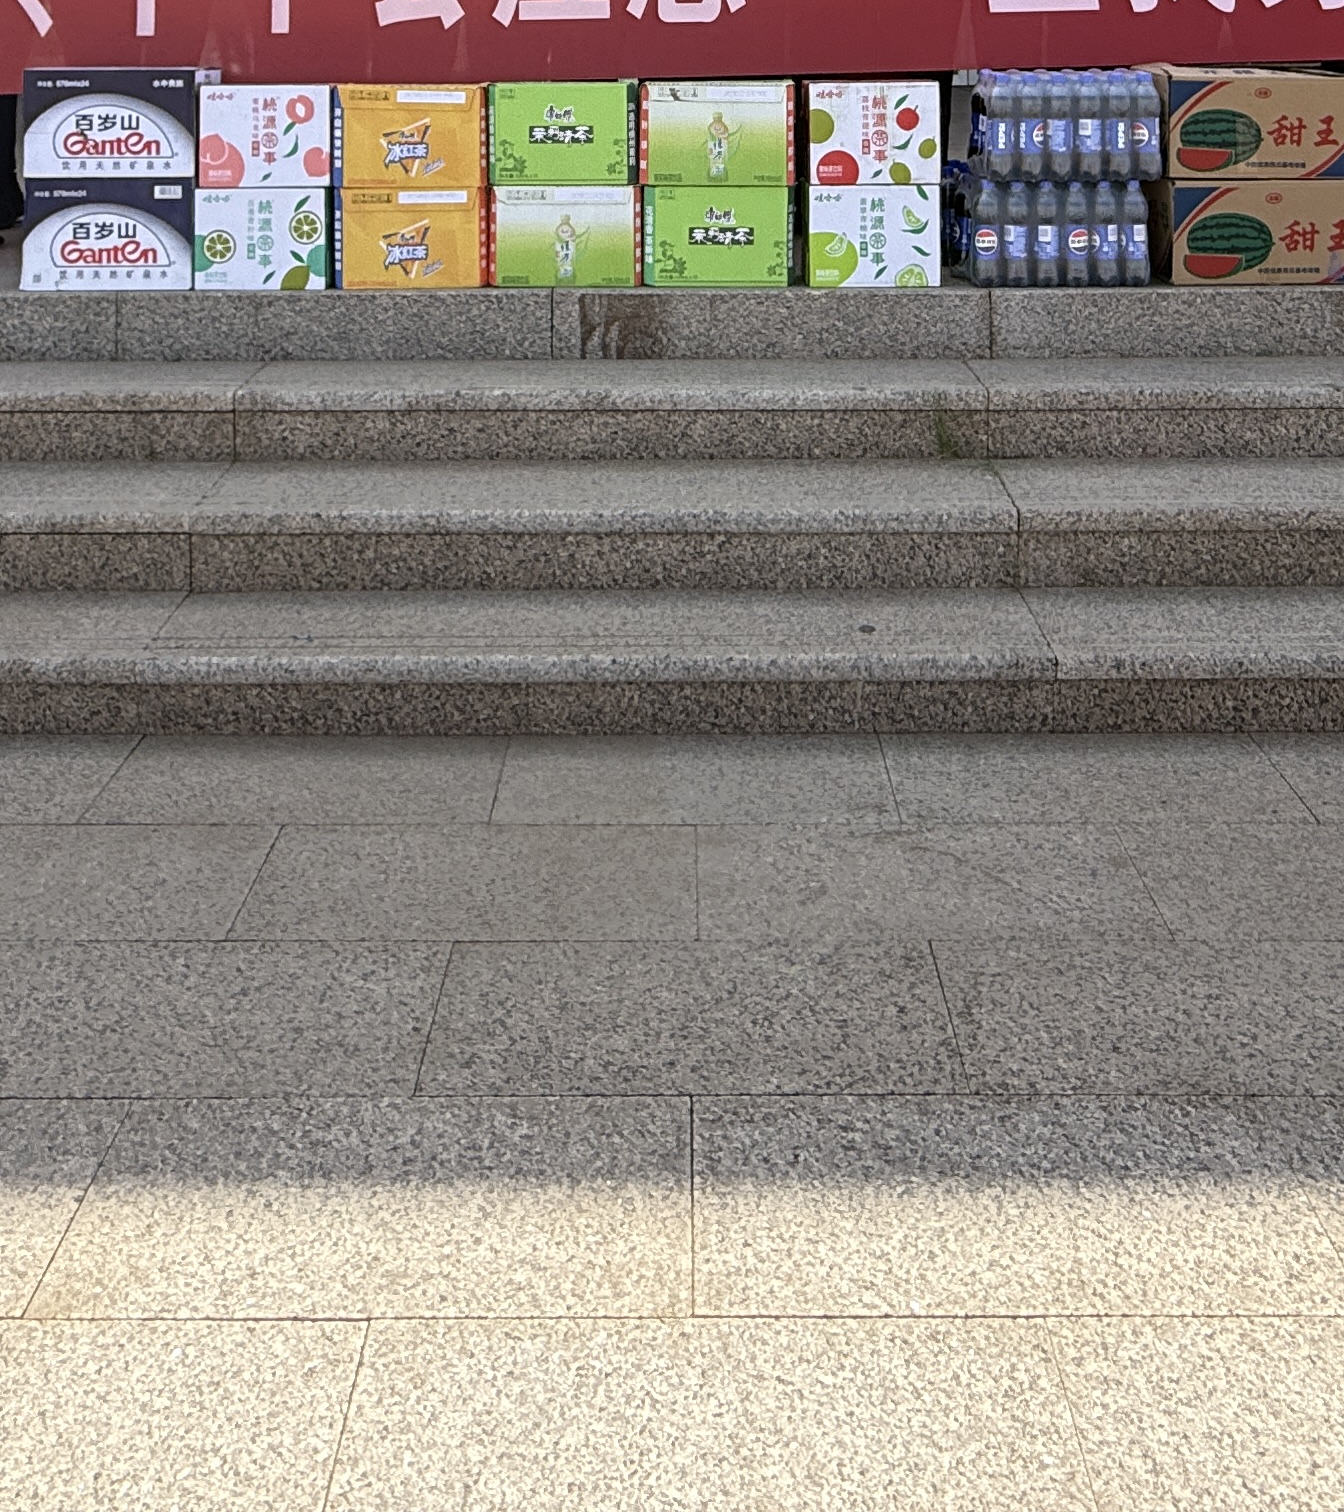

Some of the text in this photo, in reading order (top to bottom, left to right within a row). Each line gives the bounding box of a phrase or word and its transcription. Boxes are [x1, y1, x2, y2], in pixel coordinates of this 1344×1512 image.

[207, 91, 234, 101] 娃哈哈
[816, 89, 844, 99] 娃哈哈
[74, 113, 140, 132] 百岁山
[871, 95, 889, 164] 桃源茶事
[1266, 114, 1340, 148] 甜王
[998, 122, 1006, 149] PEPSI
[1117, 122, 1125, 149] PEPSI
[386, 142, 428, 164] 冰红茶
[61, 160, 172, 171] 饮用天然矿泉水
[814, 193, 842, 202] 娃哈哈
[72, 221, 137, 240] 百岁山
[869, 198, 887, 266] 桃源茶事
[386, 245, 428, 267] 冰红茶
[59, 269, 168, 280] 饮用天然矿泉水
